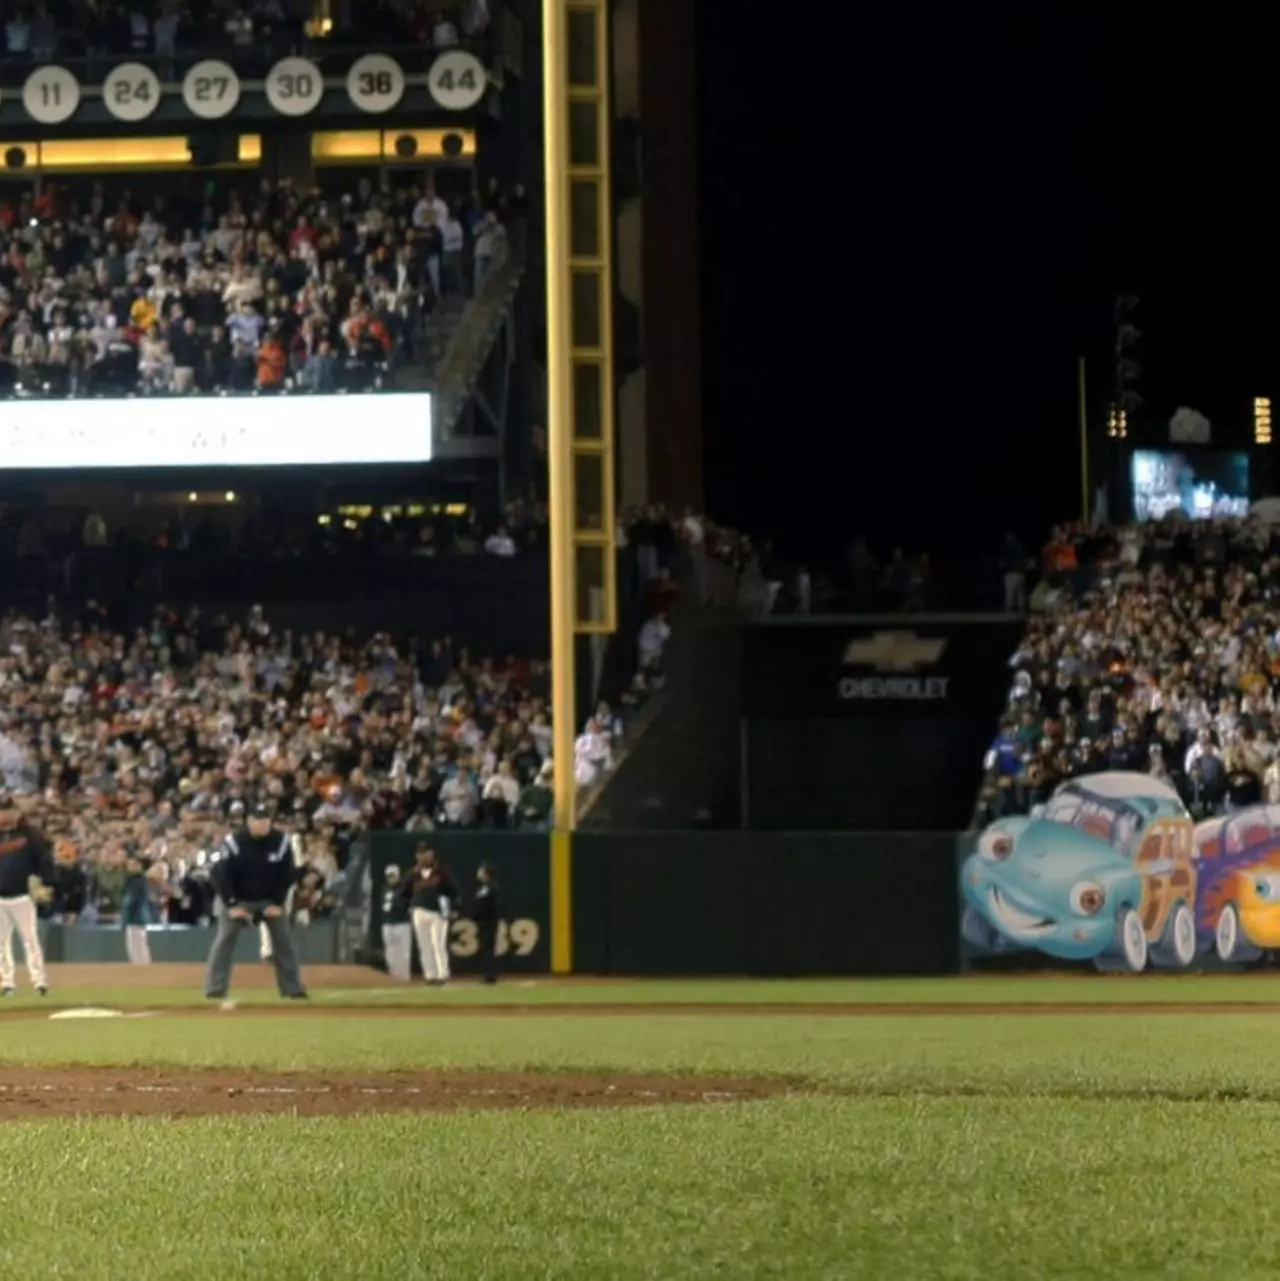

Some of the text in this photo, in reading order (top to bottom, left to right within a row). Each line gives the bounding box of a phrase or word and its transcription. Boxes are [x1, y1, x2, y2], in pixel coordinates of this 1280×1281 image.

[113, 80, 152, 104] 24
[193, 76, 230, 102] 27
[276, 73, 314, 99] 30
[436, 67, 476, 92] 44
[40, 82, 62, 107] 11
[838, 676, 949, 699] CHEVROLET
